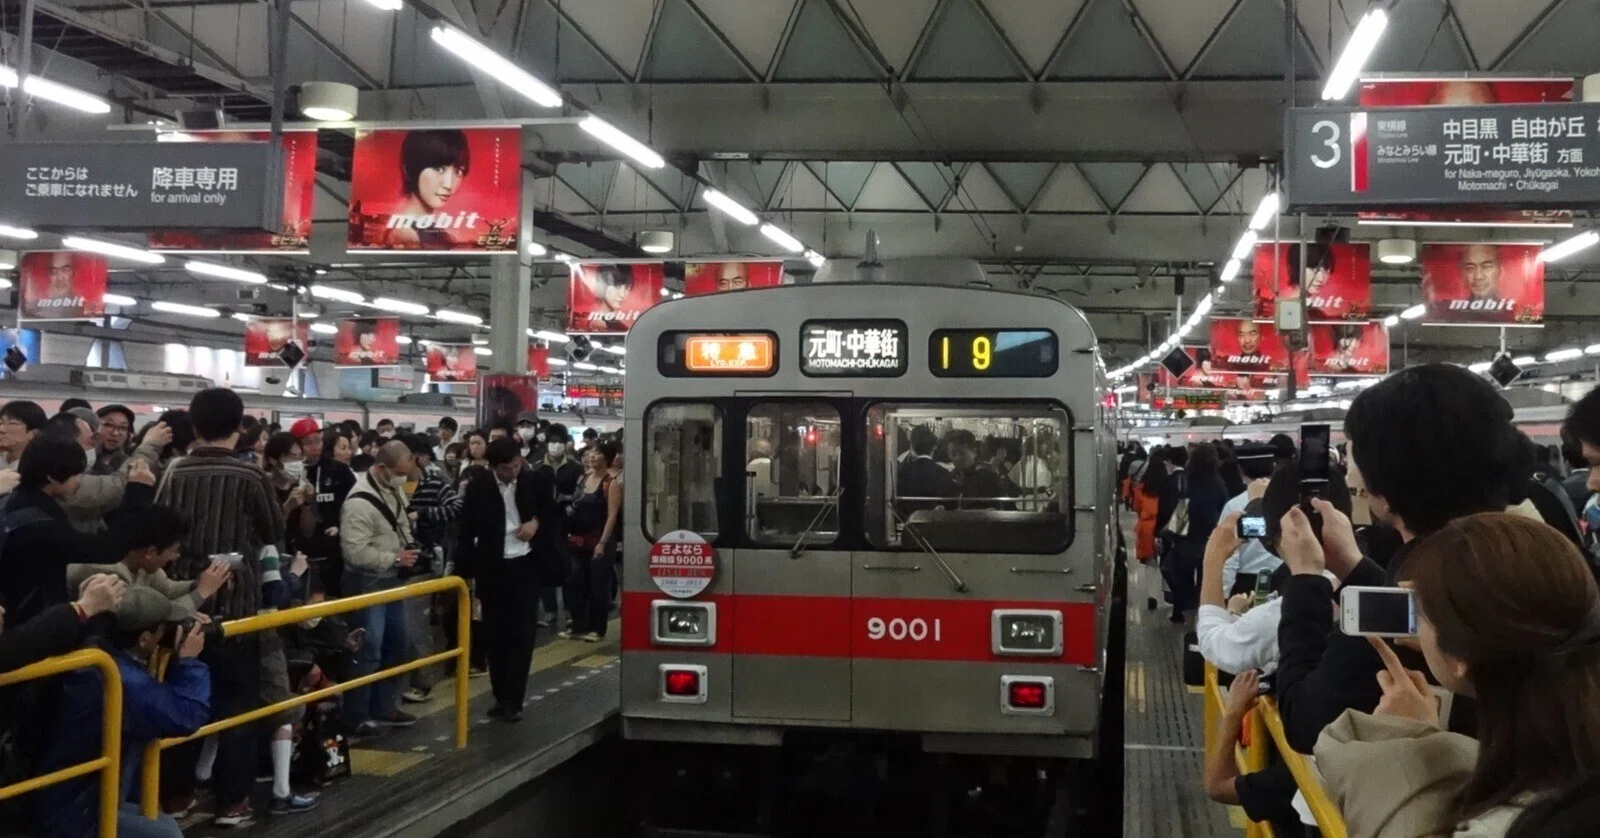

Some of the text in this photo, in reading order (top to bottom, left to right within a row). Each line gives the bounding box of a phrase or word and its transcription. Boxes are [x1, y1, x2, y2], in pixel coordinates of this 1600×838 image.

[1443, 118, 1499, 140] 中目黒
[1511, 116, 1586, 139] 自由が丘
[1311, 120, 1341, 169] 3
[1444, 143, 1583, 165] 元町・中華街 方面
[26, 167, 89, 181] ここからは
[152, 166, 238, 191] 降車専用
[1444, 169, 1456, 179] for
[25, 183, 138, 198] ご乗車になれません
[1458, 180, 1507, 191] Motomachi
[150, 191, 227, 206] for arrival only
[475, 235, 516, 247] モビット
[808, 328, 899, 358] 元町・中華街
[661, 544, 703, 555] さよなら
[867, 617, 941, 641] 9001
